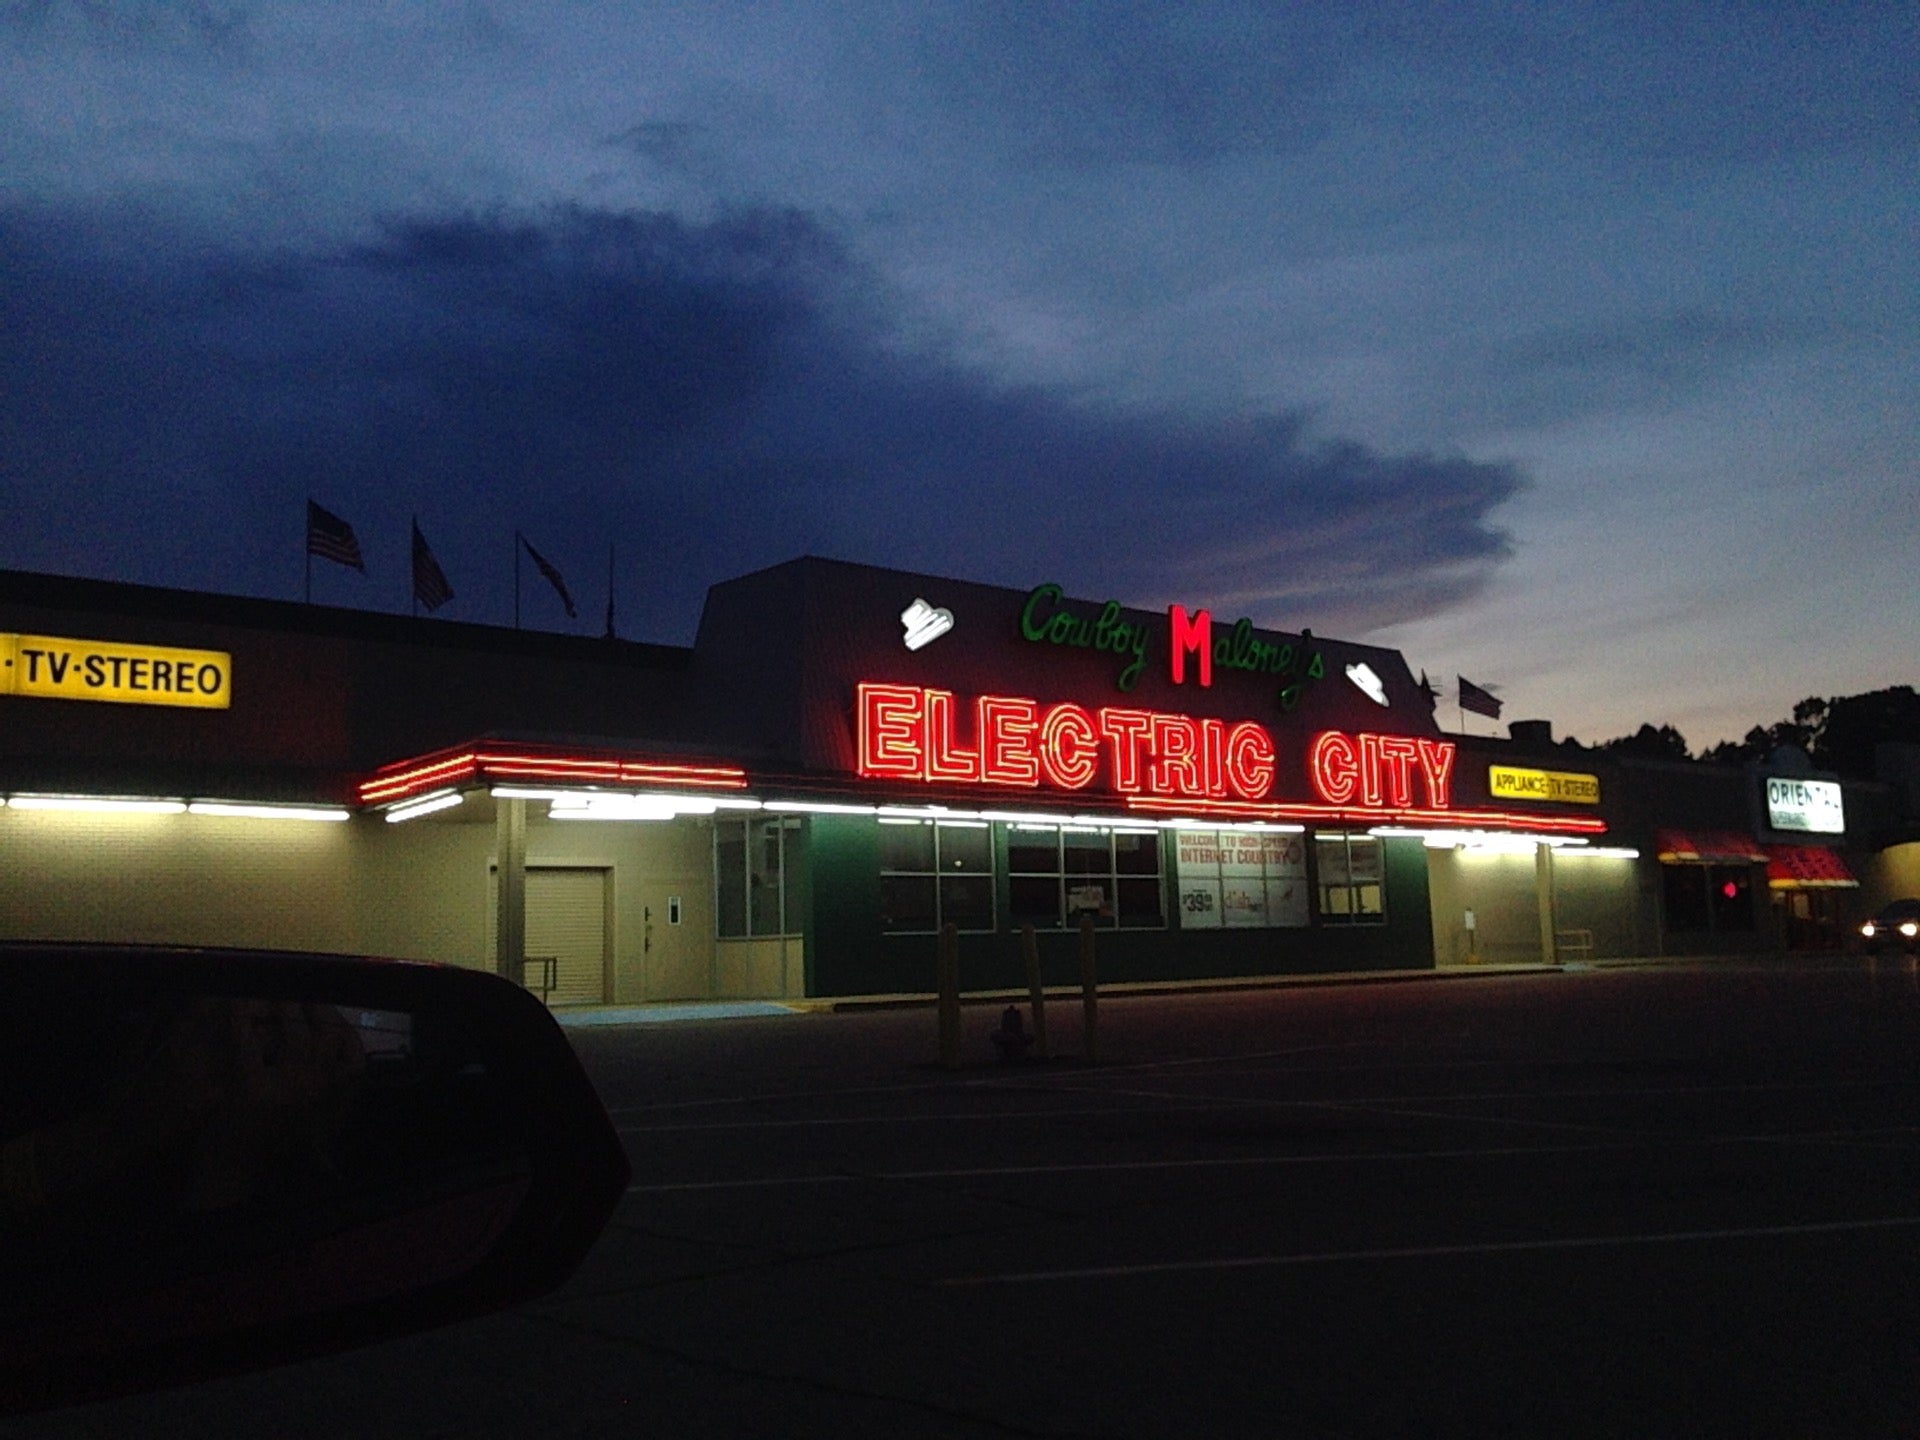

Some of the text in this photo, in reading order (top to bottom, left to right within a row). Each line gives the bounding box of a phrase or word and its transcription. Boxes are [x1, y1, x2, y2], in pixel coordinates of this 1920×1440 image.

[1020, 582, 1325, 711] Cowboy Maloney's
[857, 680, 1456, 809] ELECTRIC CITY
[1769, 781, 1840, 810] ORIEN
